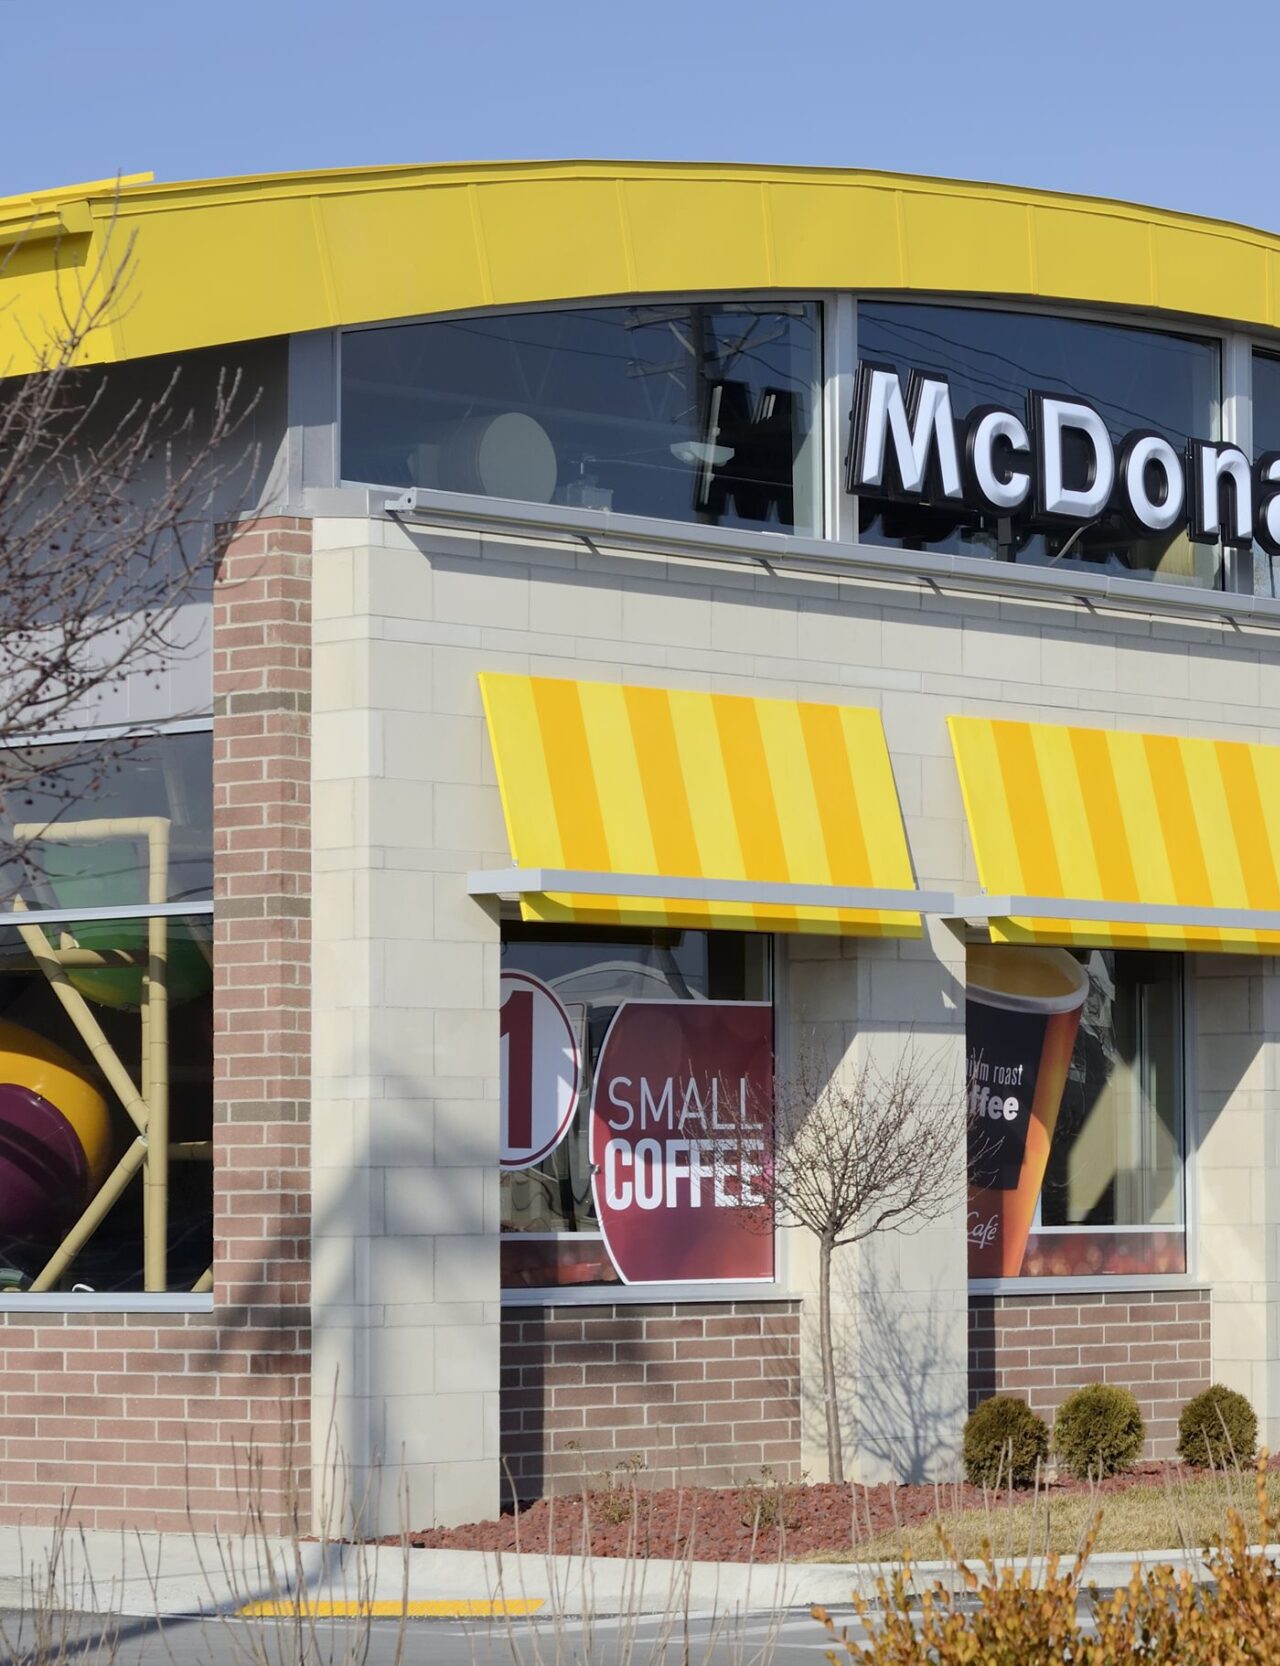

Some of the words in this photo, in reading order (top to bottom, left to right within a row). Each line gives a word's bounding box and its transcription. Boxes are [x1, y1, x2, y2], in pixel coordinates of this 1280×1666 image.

[500, 990, 533, 1149] 1
[993, 1064, 1023, 1085] roast
[608, 1076, 763, 1131] SMALL
[604, 1137, 765, 1211] COFFEE
